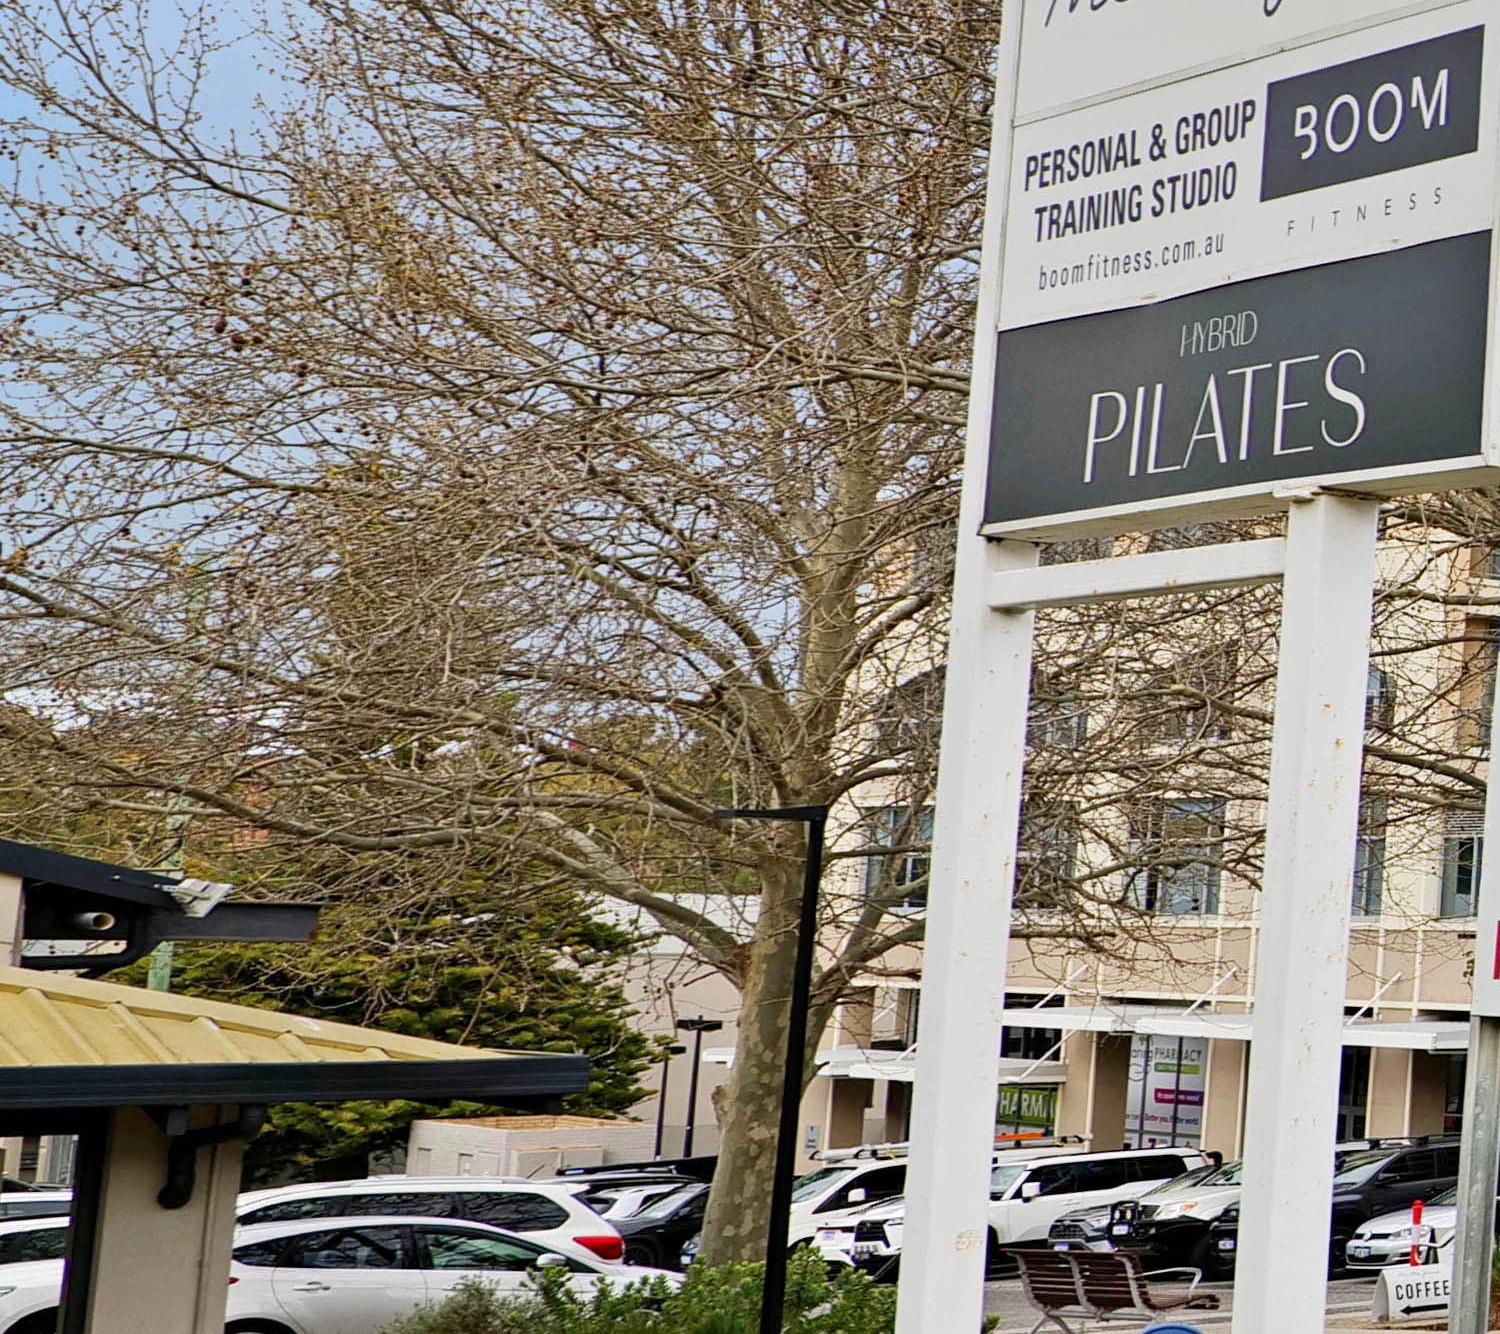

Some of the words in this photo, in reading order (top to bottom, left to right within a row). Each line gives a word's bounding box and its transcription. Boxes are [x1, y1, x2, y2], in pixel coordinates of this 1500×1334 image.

[1295, 69, 1448, 160] BOOM
[1023, 125, 1141, 192] PERSONAL
[1149, 123, 1168, 160] &
[1174, 99, 1257, 155] GROUP
[1033, 178, 1144, 243] TRAINING
[1151, 160, 1239, 219] STUDIO
[1287, 185, 1445, 237] FITNESS
[1037, 232, 1226, 292] boomfitness.com.au
[1180, 309, 1260, 357] HYBRID
[1083, 348, 1368, 483] PILATES
[1154, 1048, 1202, 1062] PHARACY
[1395, 1280, 1451, 1301] COFFEE
